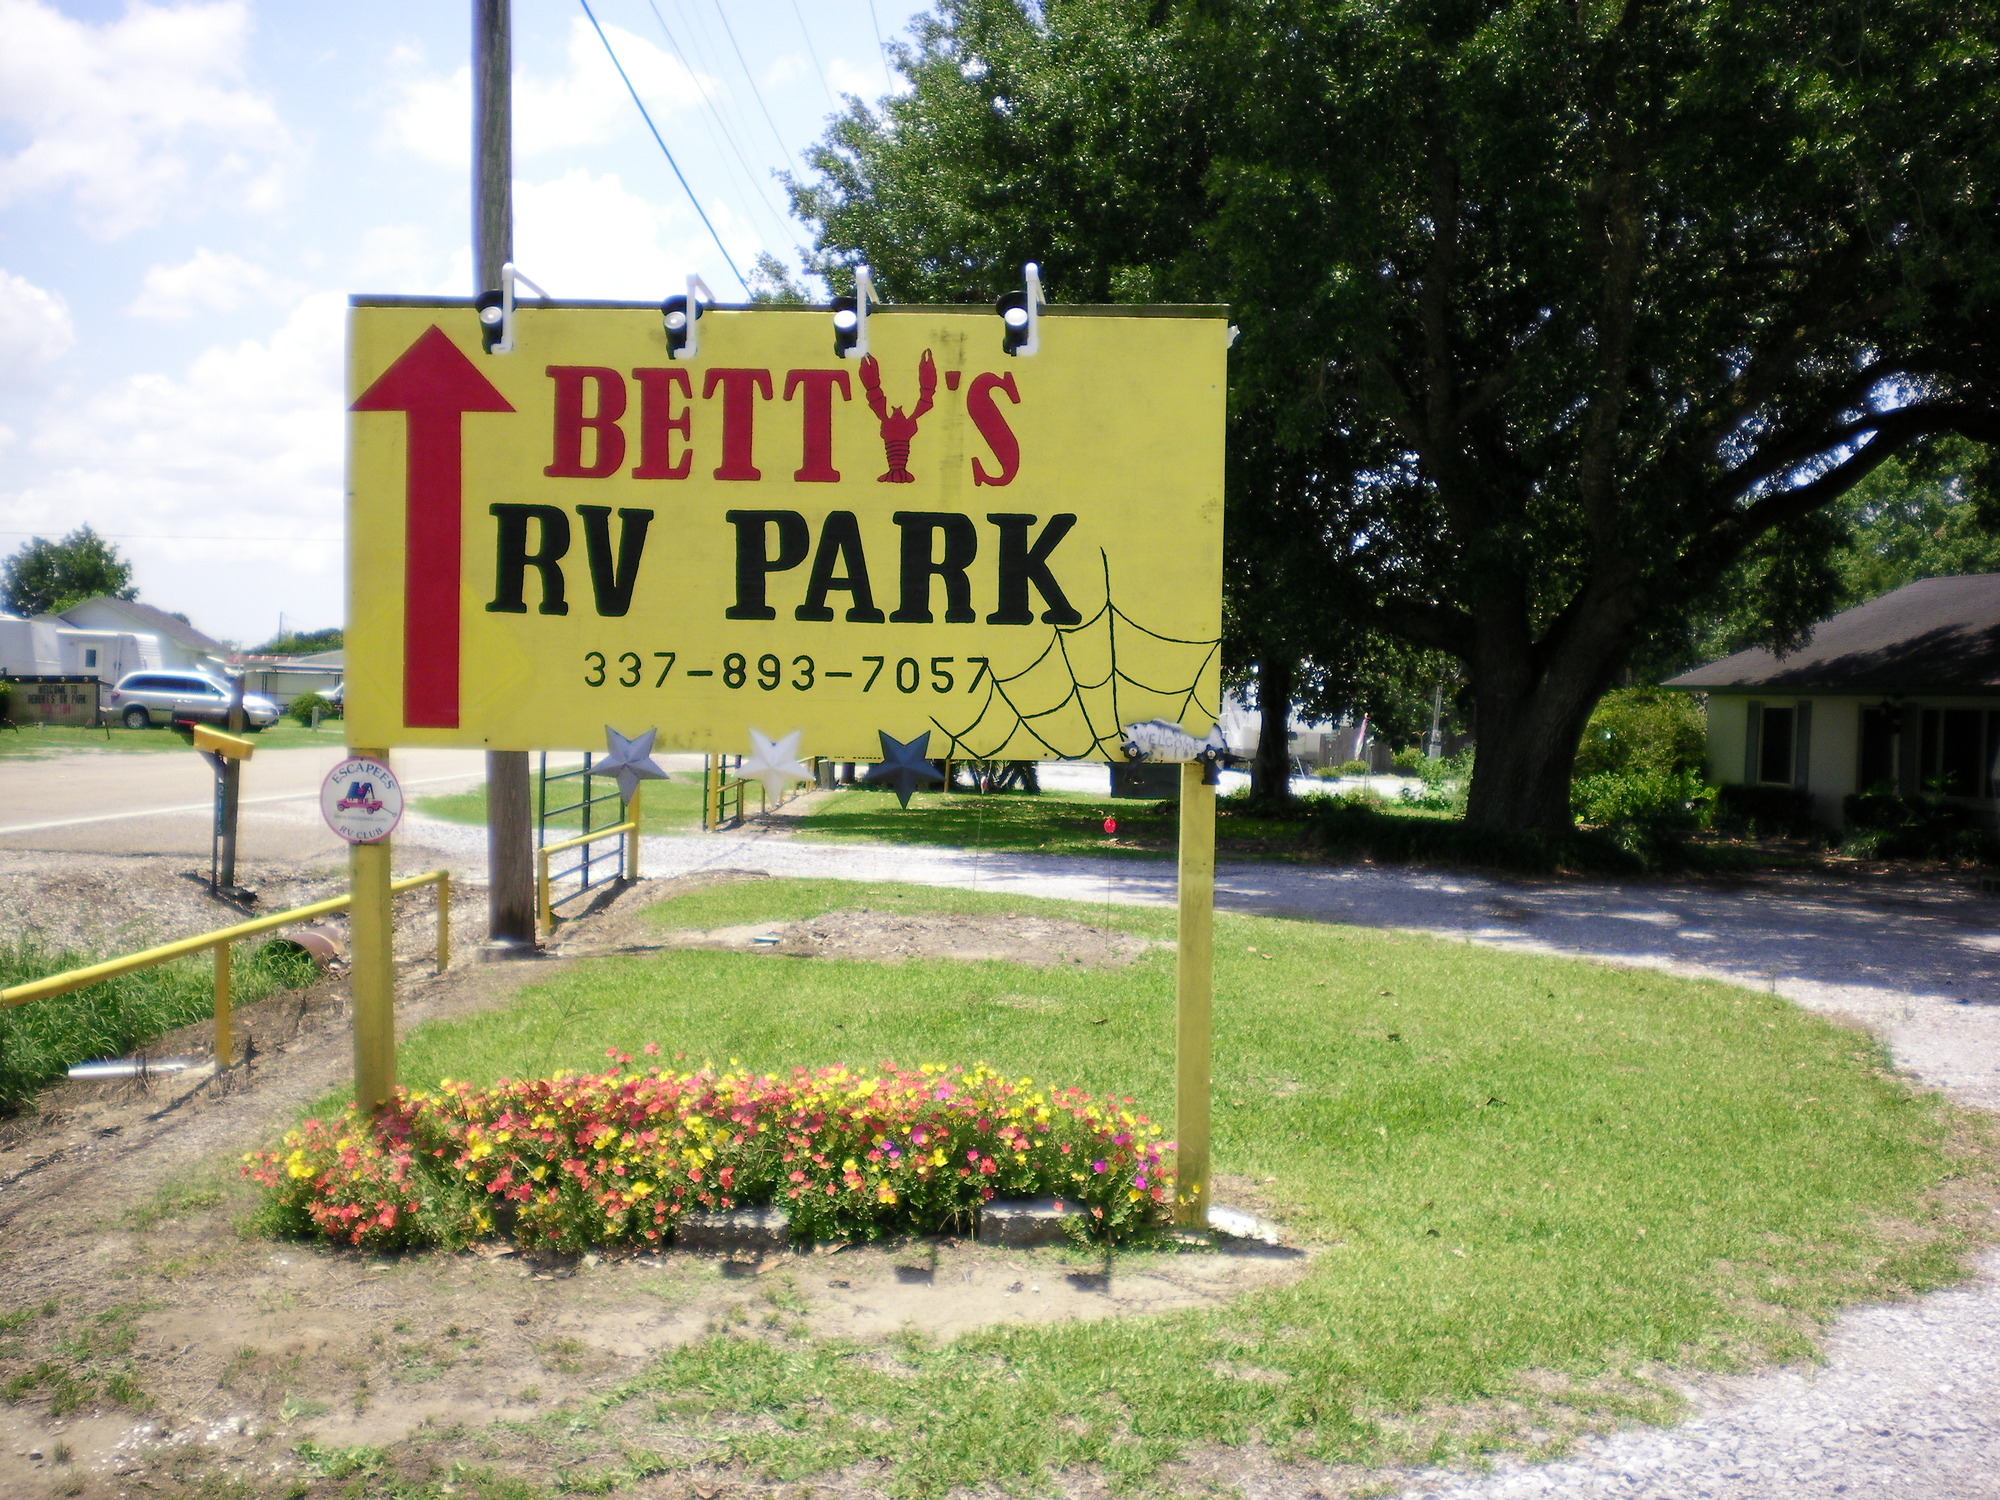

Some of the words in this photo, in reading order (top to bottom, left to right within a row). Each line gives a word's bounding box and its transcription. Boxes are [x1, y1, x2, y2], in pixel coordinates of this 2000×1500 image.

[543, 347, 1022, 487] BETTY'S
[485, 502, 655, 618] RV
[725, 509, 1083, 626] PARK
[584, 651, 991, 694] 337-893-7057
[1136, 731, 1199, 751] WELCOME
[331, 762, 395, 790] ESCAPEES
[340, 825, 354, 836] RV
[356, 827, 383, 839] CLUB
